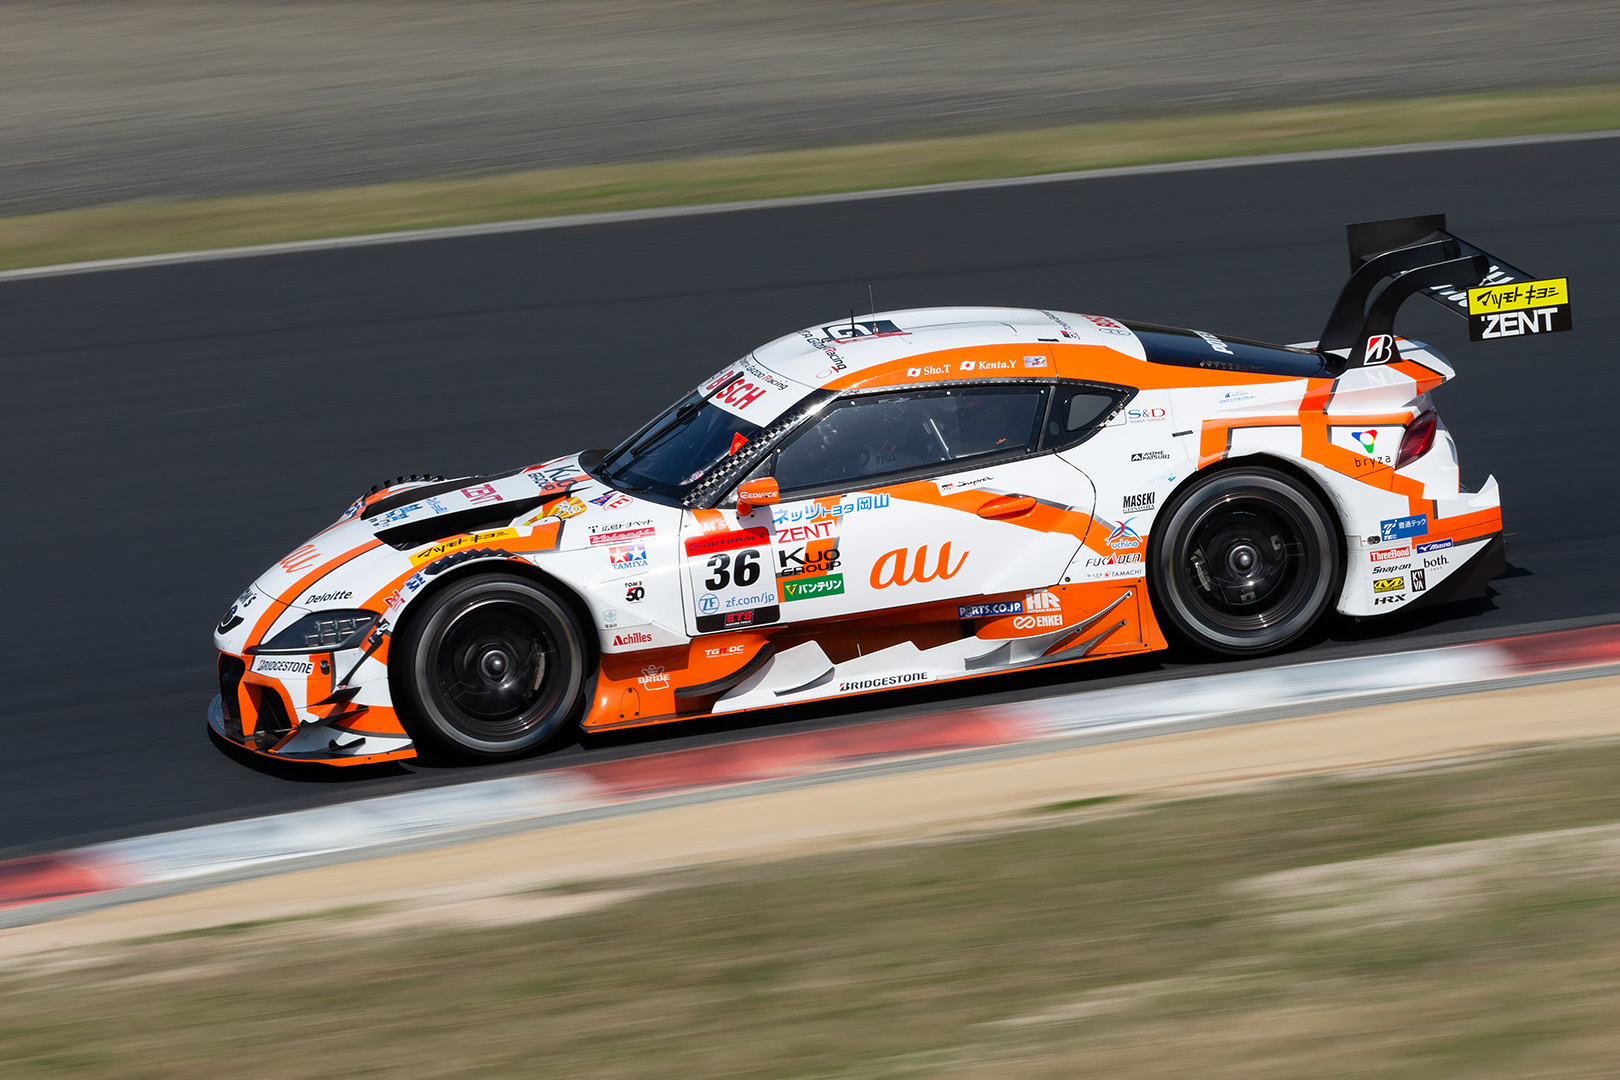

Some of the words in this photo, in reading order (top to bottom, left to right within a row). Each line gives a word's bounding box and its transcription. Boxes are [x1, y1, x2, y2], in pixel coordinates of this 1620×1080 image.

[1481, 307, 1559, 339] ZENT
[923, 364, 951, 376] Sho.T
[978, 359, 1017, 370] Kenta.Y
[705, 370, 767, 411] BSCH
[1128, 407, 1166, 420] S&D
[1354, 455, 1392, 468] bryza
[1122, 491, 1156, 509] MASEKI
[771, 493, 890, 525] ネッツトヨタ岡山
[775, 521, 834, 544] ZENT
[1111, 539, 1139, 549] uchino
[778, 547, 841, 568] KUO
[1371, 546, 1410, 561] ThreeBond
[612, 559, 649, 570] TAMIYA
[704, 549, 761, 591] 36
[781, 560, 842, 577] GROUP
[868, 540, 971, 590] au
[1111, 569, 1142, 577] TAMACHI
[625, 586, 646, 602] 50
[725, 592, 775, 608] zf.com/jp
[1374, 593, 1407, 606] HRX
[726, 610, 753, 623] ETS
[1036, 614, 1063, 627] ENKEI
[613, 632, 653, 646] Achilles
[257, 659, 313, 674] BRIDGESTONE
[637, 673, 671, 684] BRIDE
[839, 671, 928, 692] BRIDGESTONE
